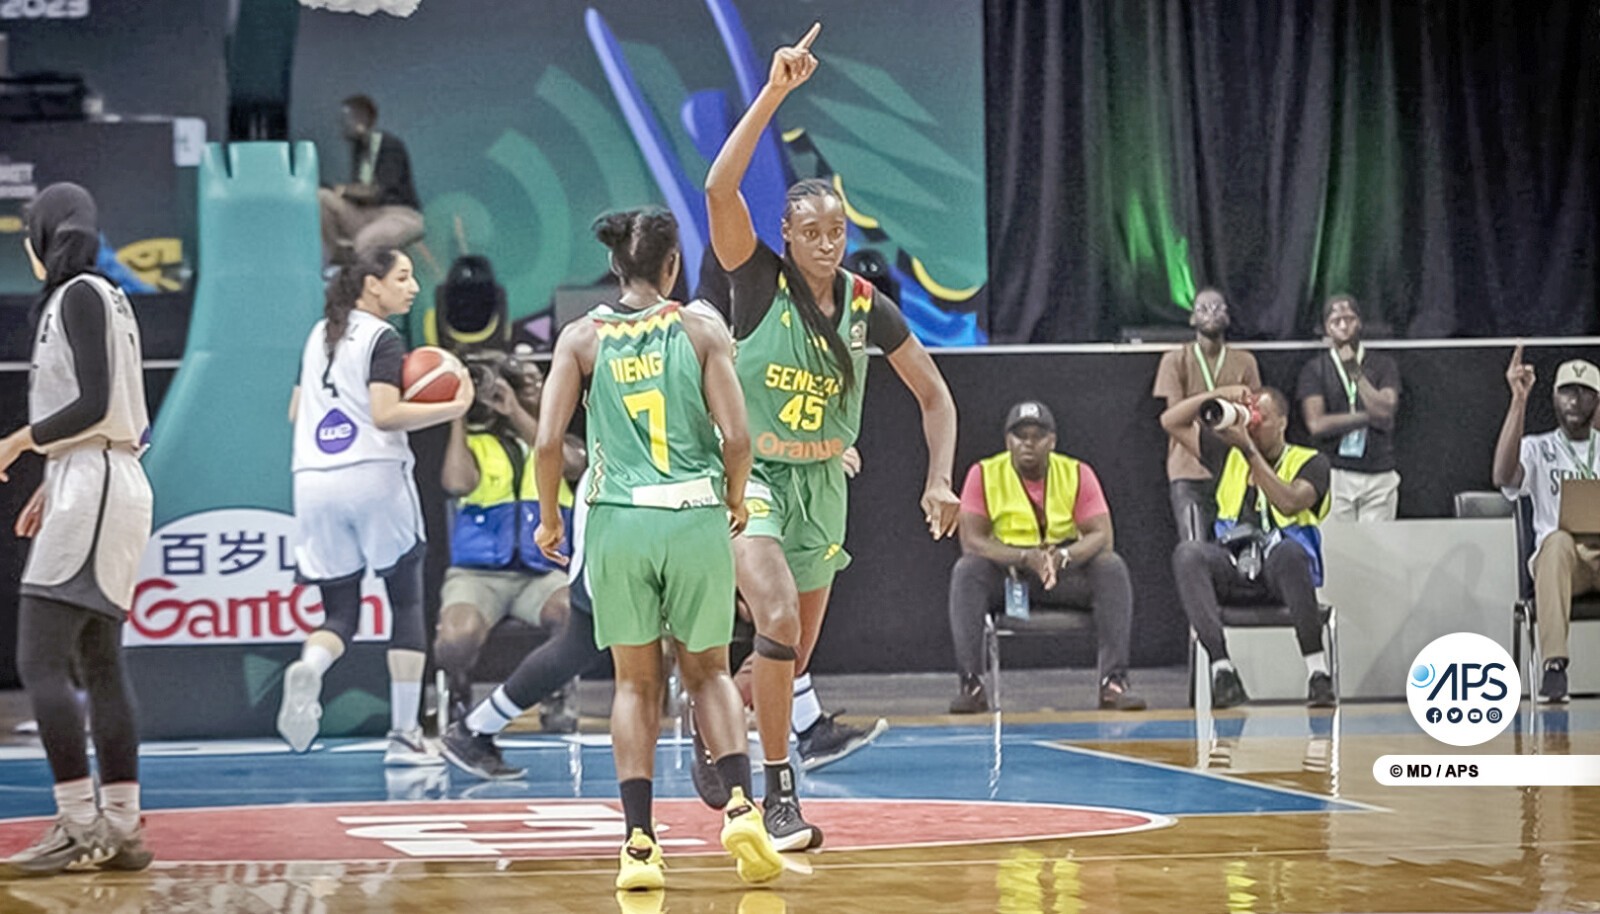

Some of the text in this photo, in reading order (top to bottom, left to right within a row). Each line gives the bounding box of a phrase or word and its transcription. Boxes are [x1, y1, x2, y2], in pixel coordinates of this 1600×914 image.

[623, 388, 671, 475] 7
[778, 394, 827, 432] 45
[757, 432, 843, 459] Orange
